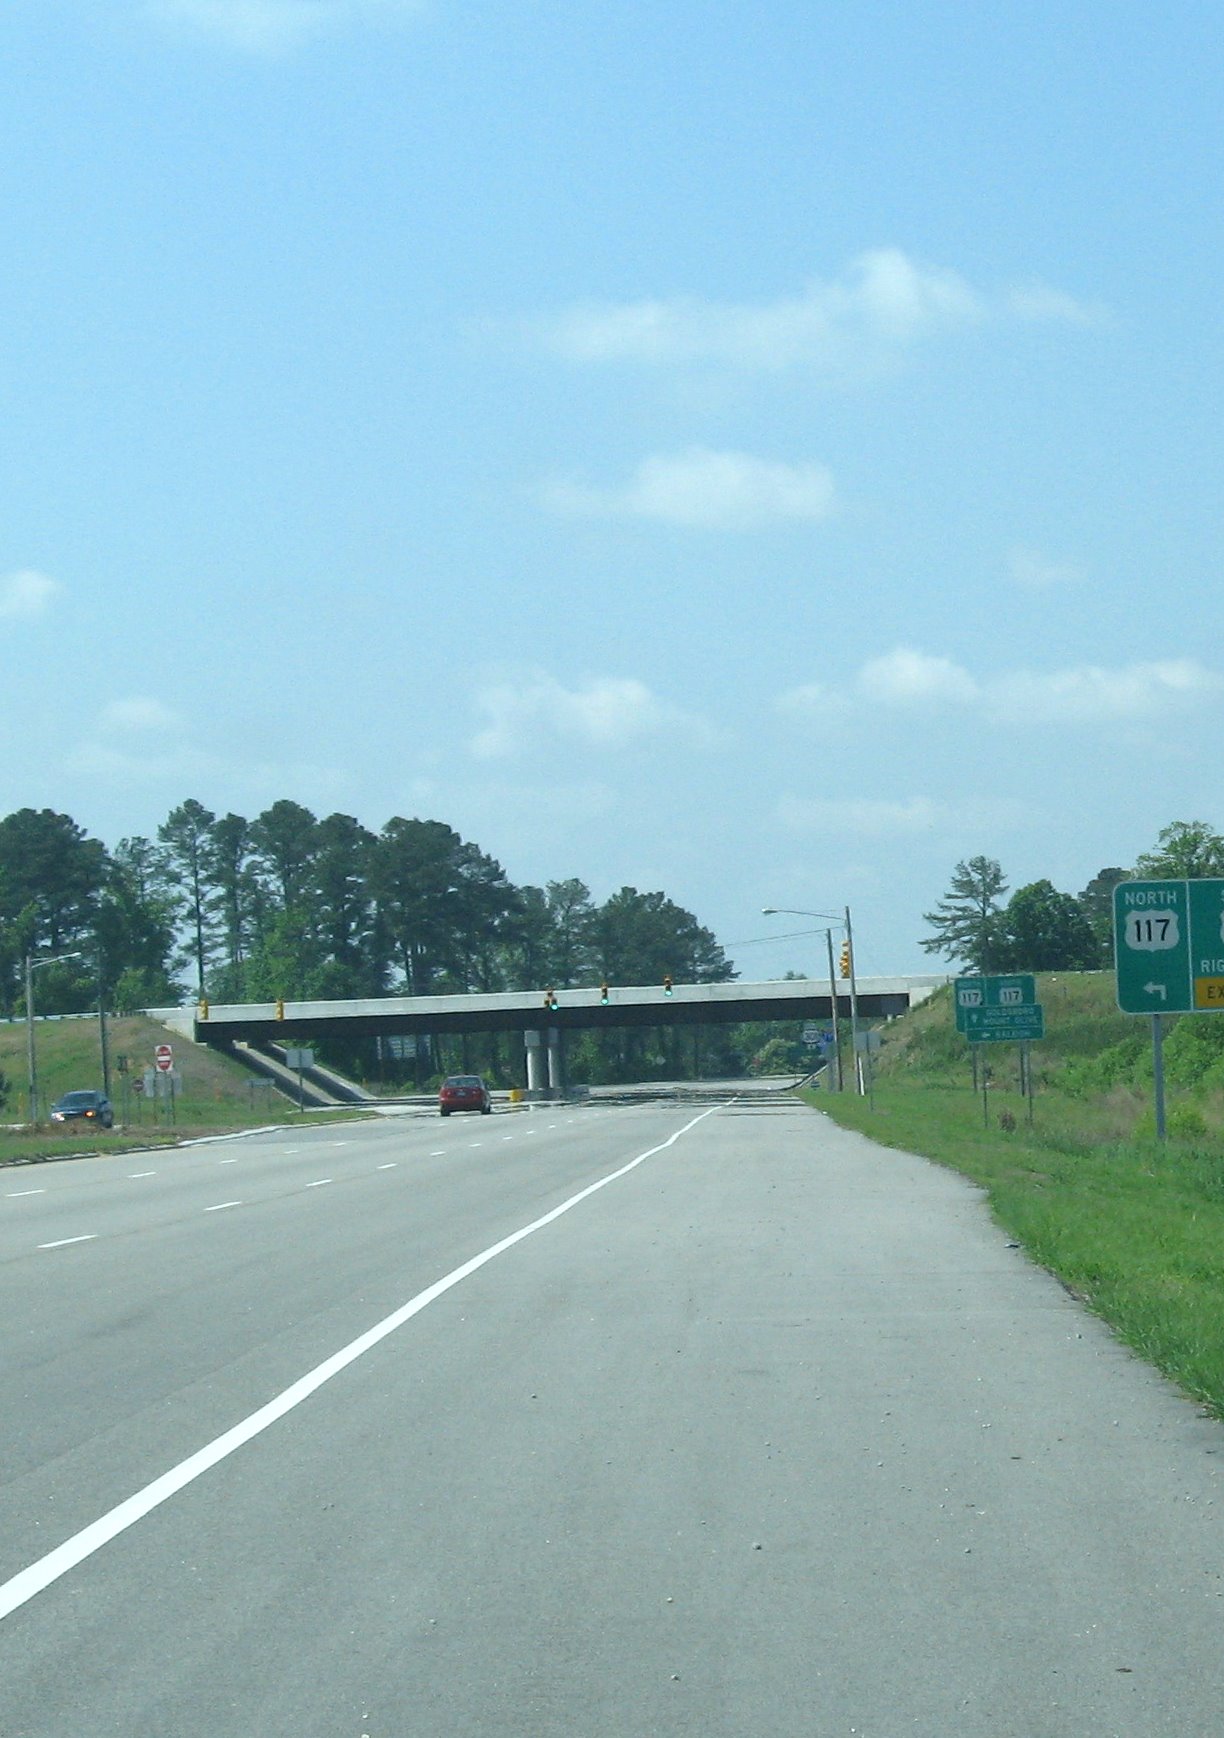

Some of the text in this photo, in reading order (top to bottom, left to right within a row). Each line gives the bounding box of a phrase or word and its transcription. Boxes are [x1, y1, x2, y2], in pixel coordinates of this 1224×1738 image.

[1125, 890, 1177, 905] NORTH
[1134, 918, 1170, 942] 117
[963, 992, 979, 1003] 117
[1003, 991, 1020, 1001] 117
